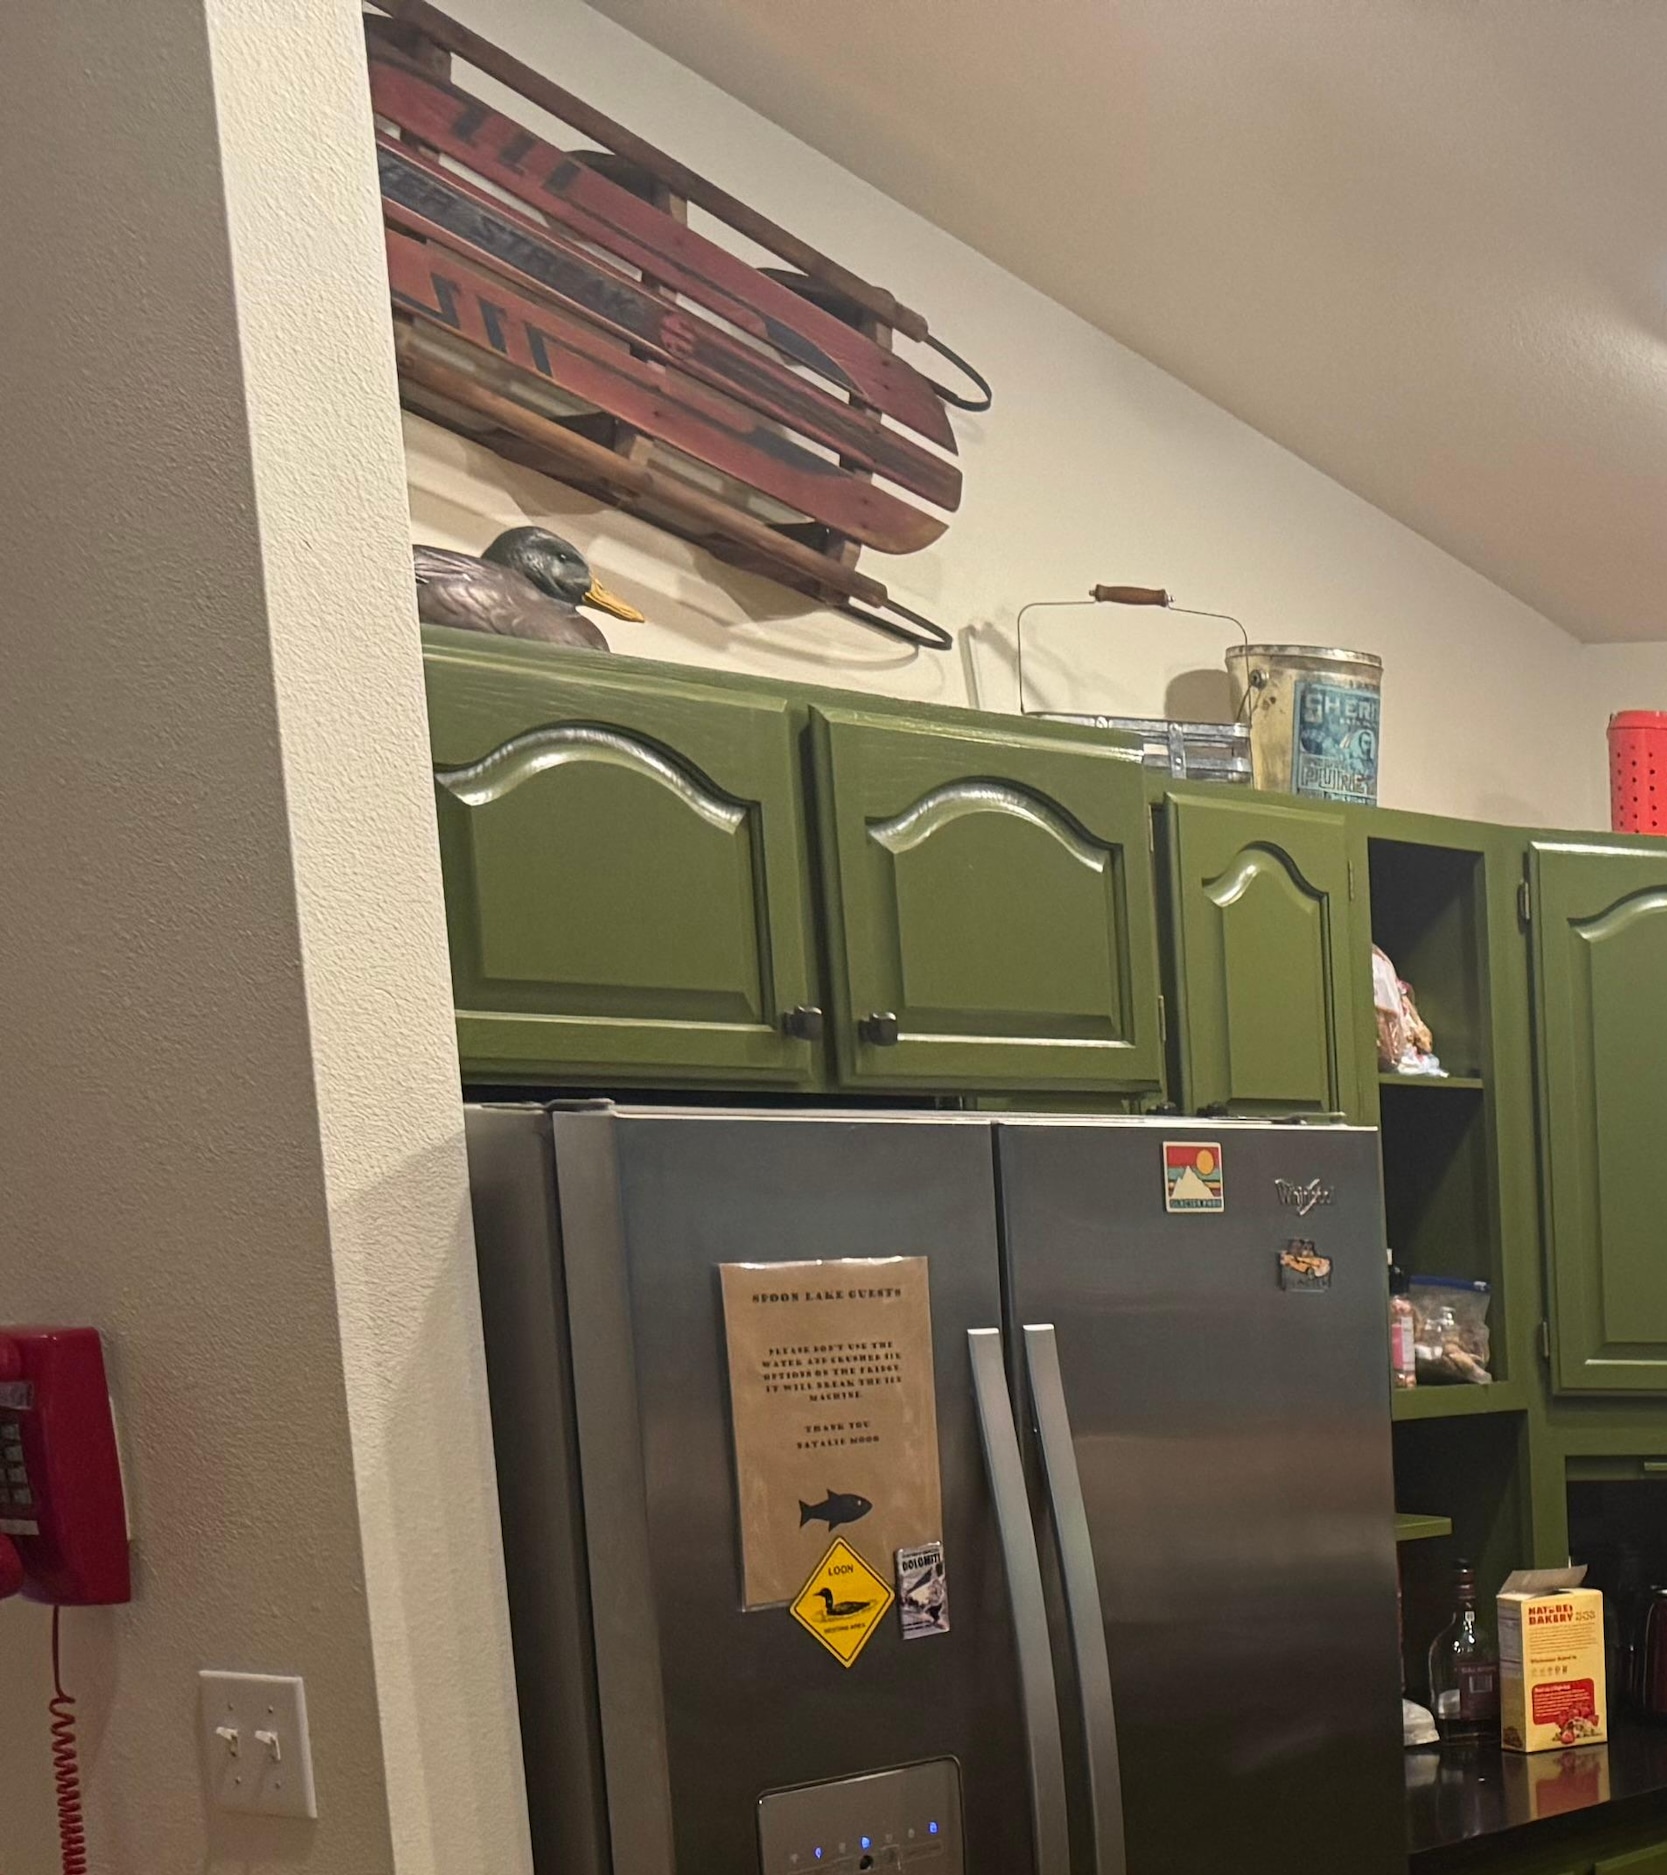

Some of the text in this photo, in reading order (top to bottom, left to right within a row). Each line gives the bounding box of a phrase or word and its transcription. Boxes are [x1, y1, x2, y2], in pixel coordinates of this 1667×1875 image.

[752, 1288, 901, 1303] SPOON LAKE GUESTS
[848, 1342, 867, 1350] USE
[872, 1341, 893, 1349] THE
[762, 1360, 802, 1368] WATER
[833, 1367, 855, 1375] THE
[783, 1382, 812, 1391] WILL
[859, 1377, 880, 1386] THE
[828, 1564, 854, 1576] LOON
[1528, 1613, 1574, 1625] BAKERY
